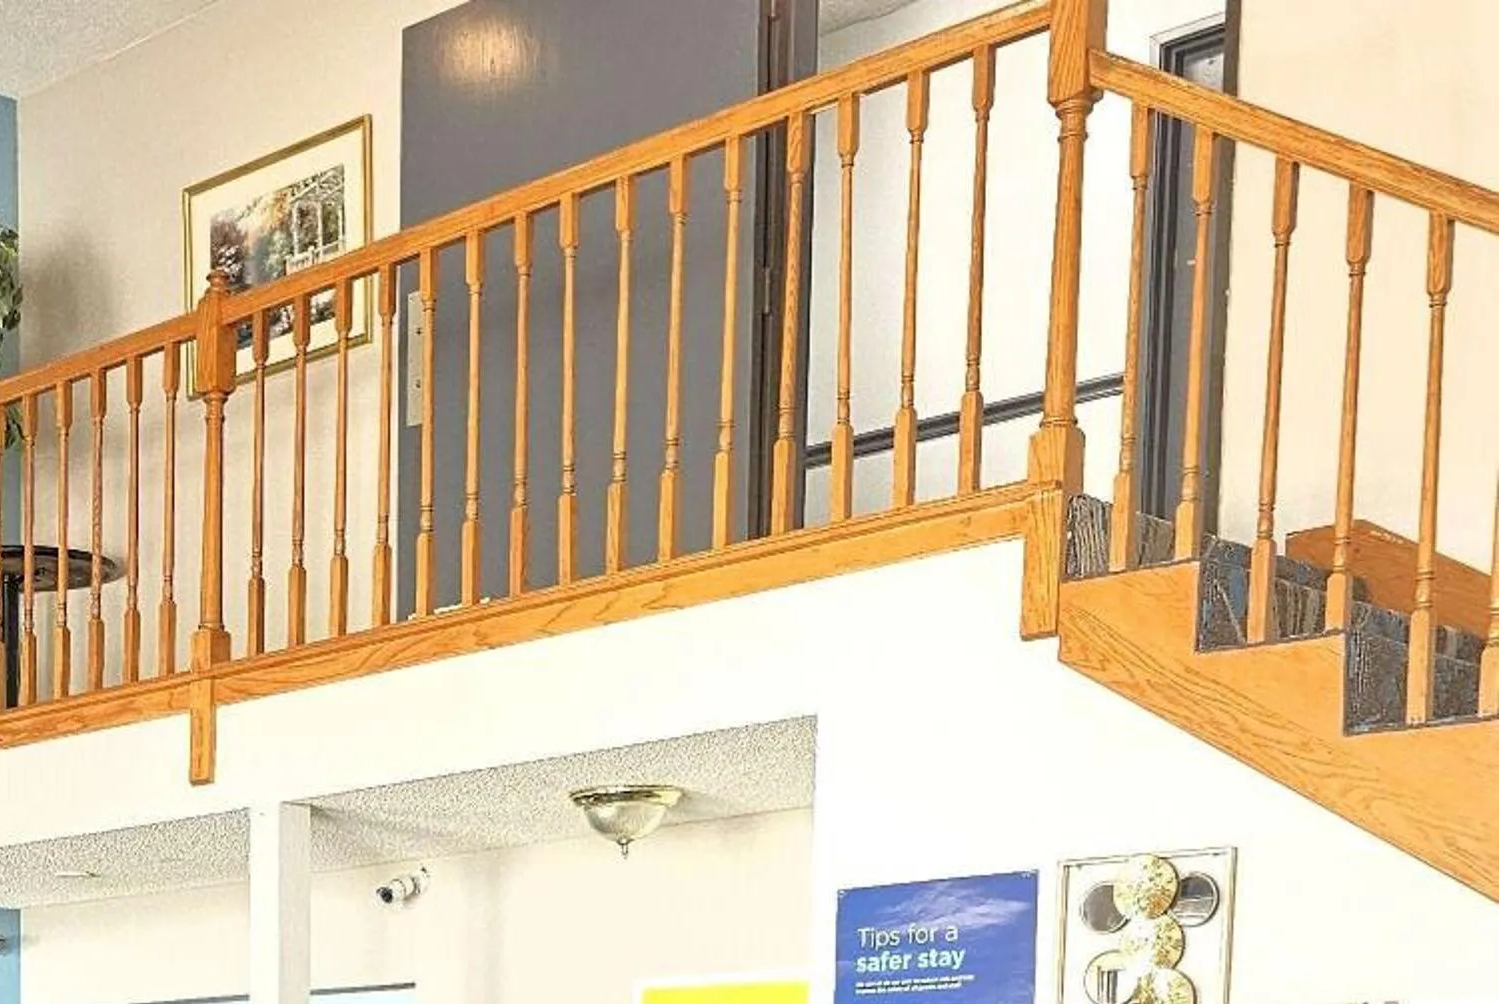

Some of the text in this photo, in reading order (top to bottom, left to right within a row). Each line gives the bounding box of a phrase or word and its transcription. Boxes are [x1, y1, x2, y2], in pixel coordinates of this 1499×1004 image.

[856, 922, 959, 951] Tips for a
[856, 948, 966, 973] safer stay
